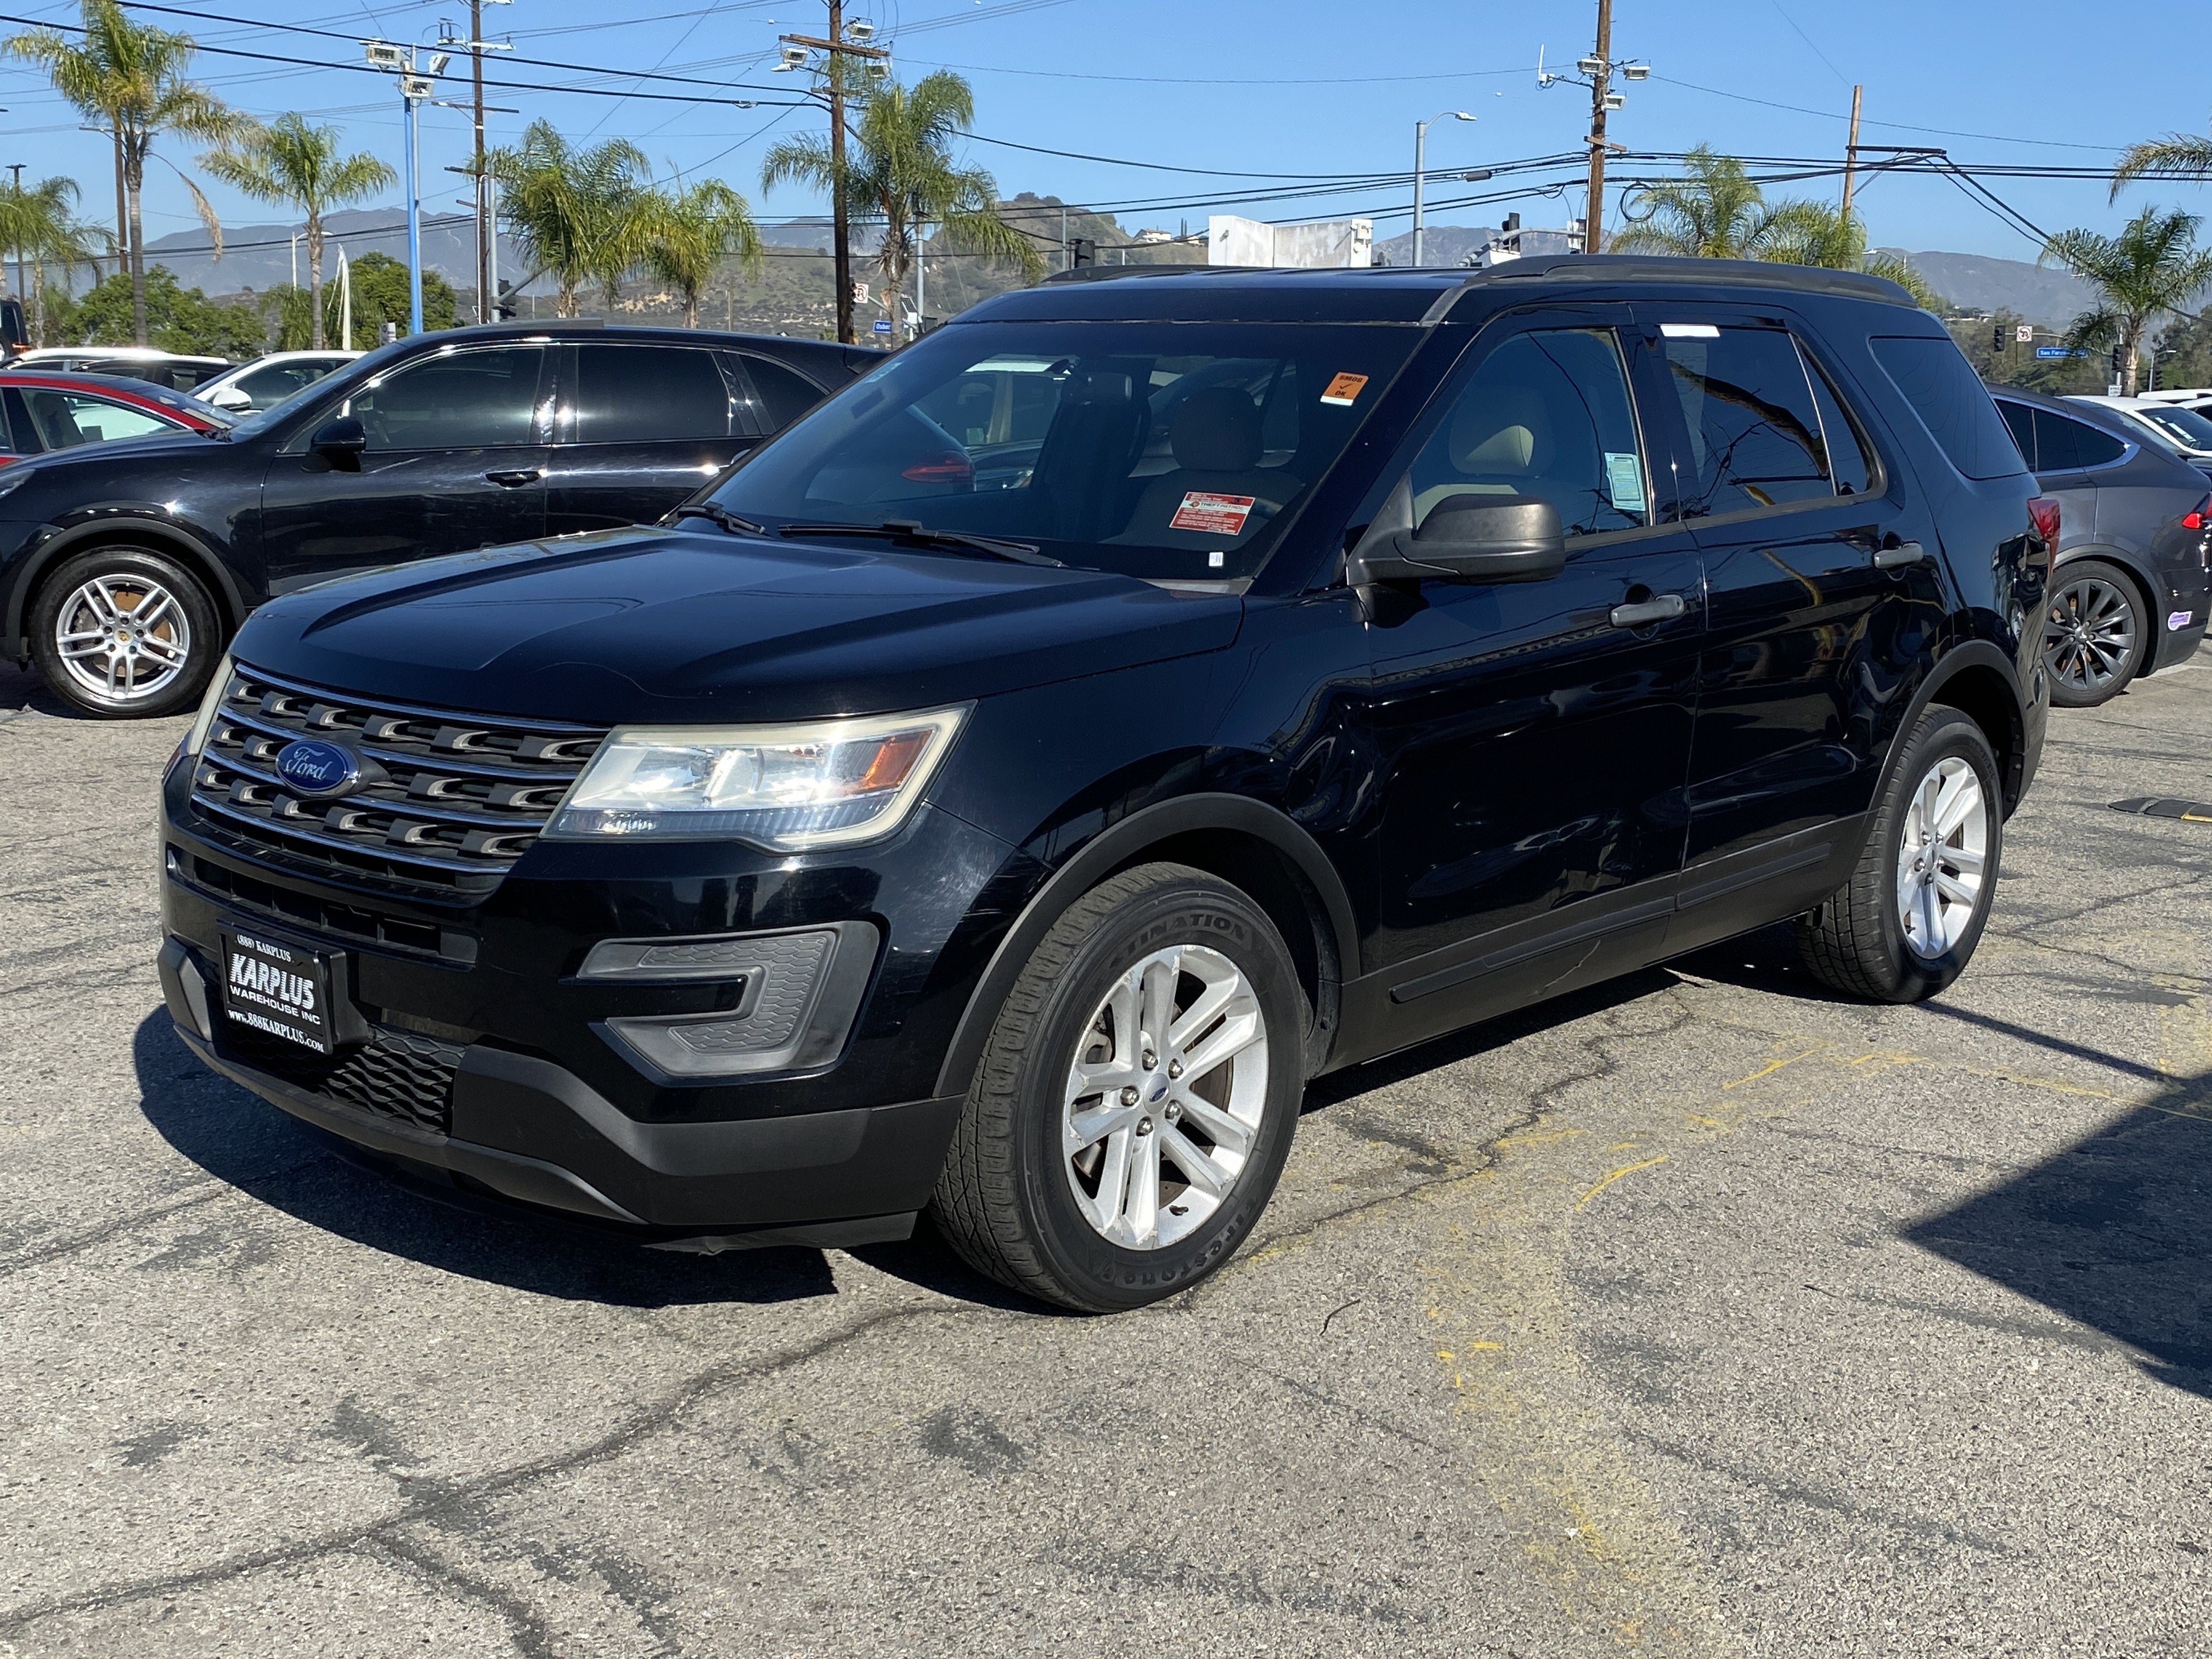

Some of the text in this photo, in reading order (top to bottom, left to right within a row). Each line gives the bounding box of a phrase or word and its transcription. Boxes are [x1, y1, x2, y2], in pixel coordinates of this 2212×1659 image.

[284, 746, 332, 781] Ford
[255, 940, 291, 962] KARPLUS
[230, 953, 314, 1009] KARPLUS
[230, 985, 321, 1025] WAREHOUSE INC
